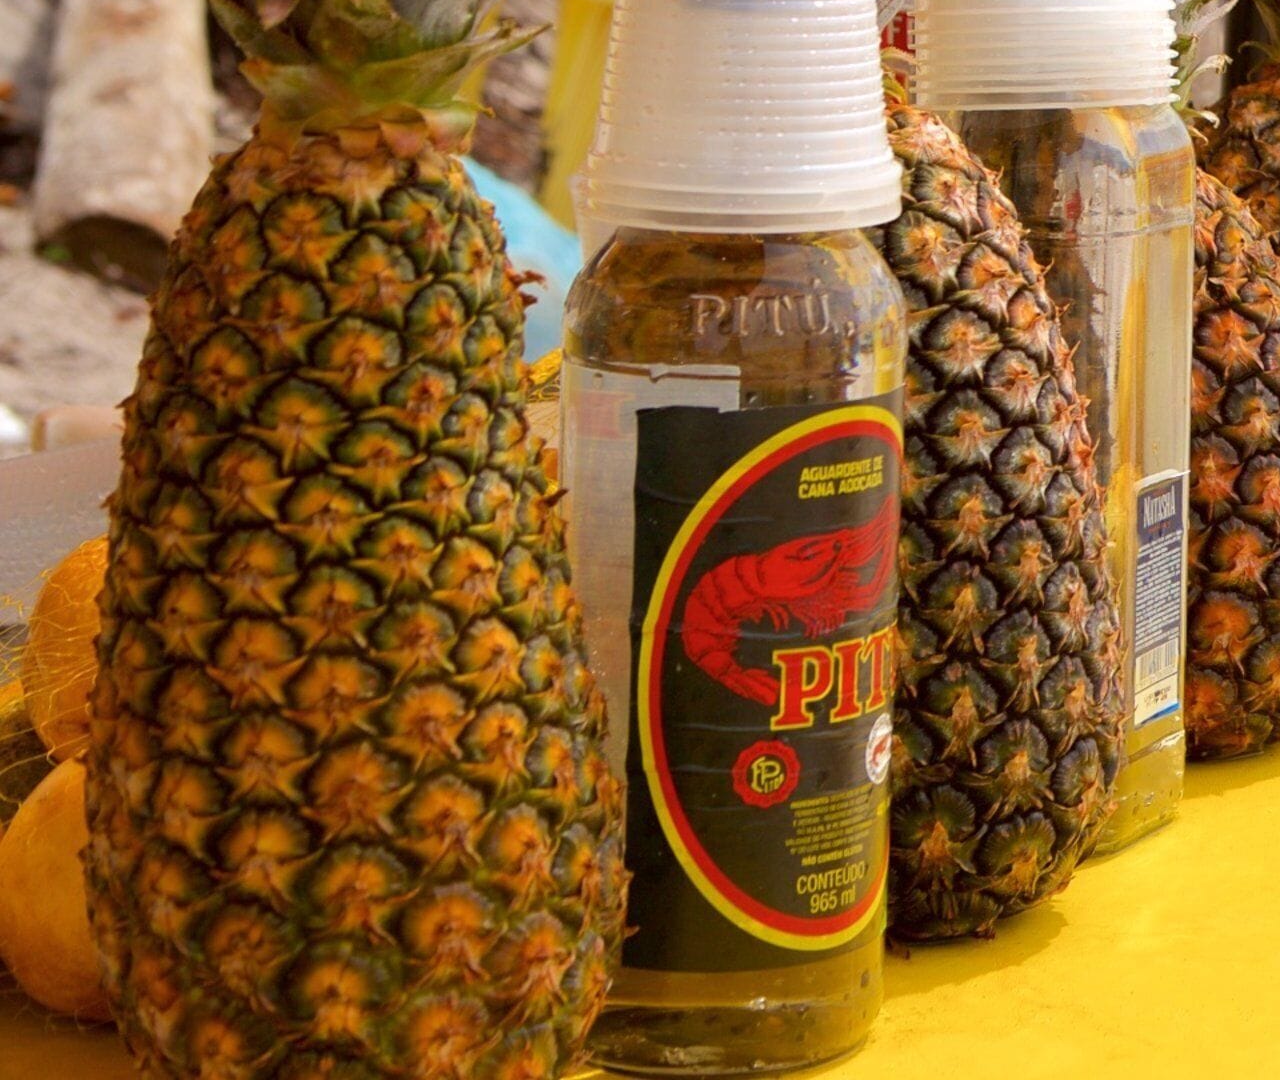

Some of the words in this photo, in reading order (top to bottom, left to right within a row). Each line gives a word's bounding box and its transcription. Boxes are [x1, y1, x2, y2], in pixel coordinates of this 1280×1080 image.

[688, 277, 831, 337] PITÚ
[799, 458, 872, 482] AGUARDENTE
[798, 481, 836, 500] CANA
[770, 624, 897, 732] PIT
[796, 861, 866, 896] CONTEÚDO
[810, 888, 838, 915] 965
[841, 883, 857, 907] ml
